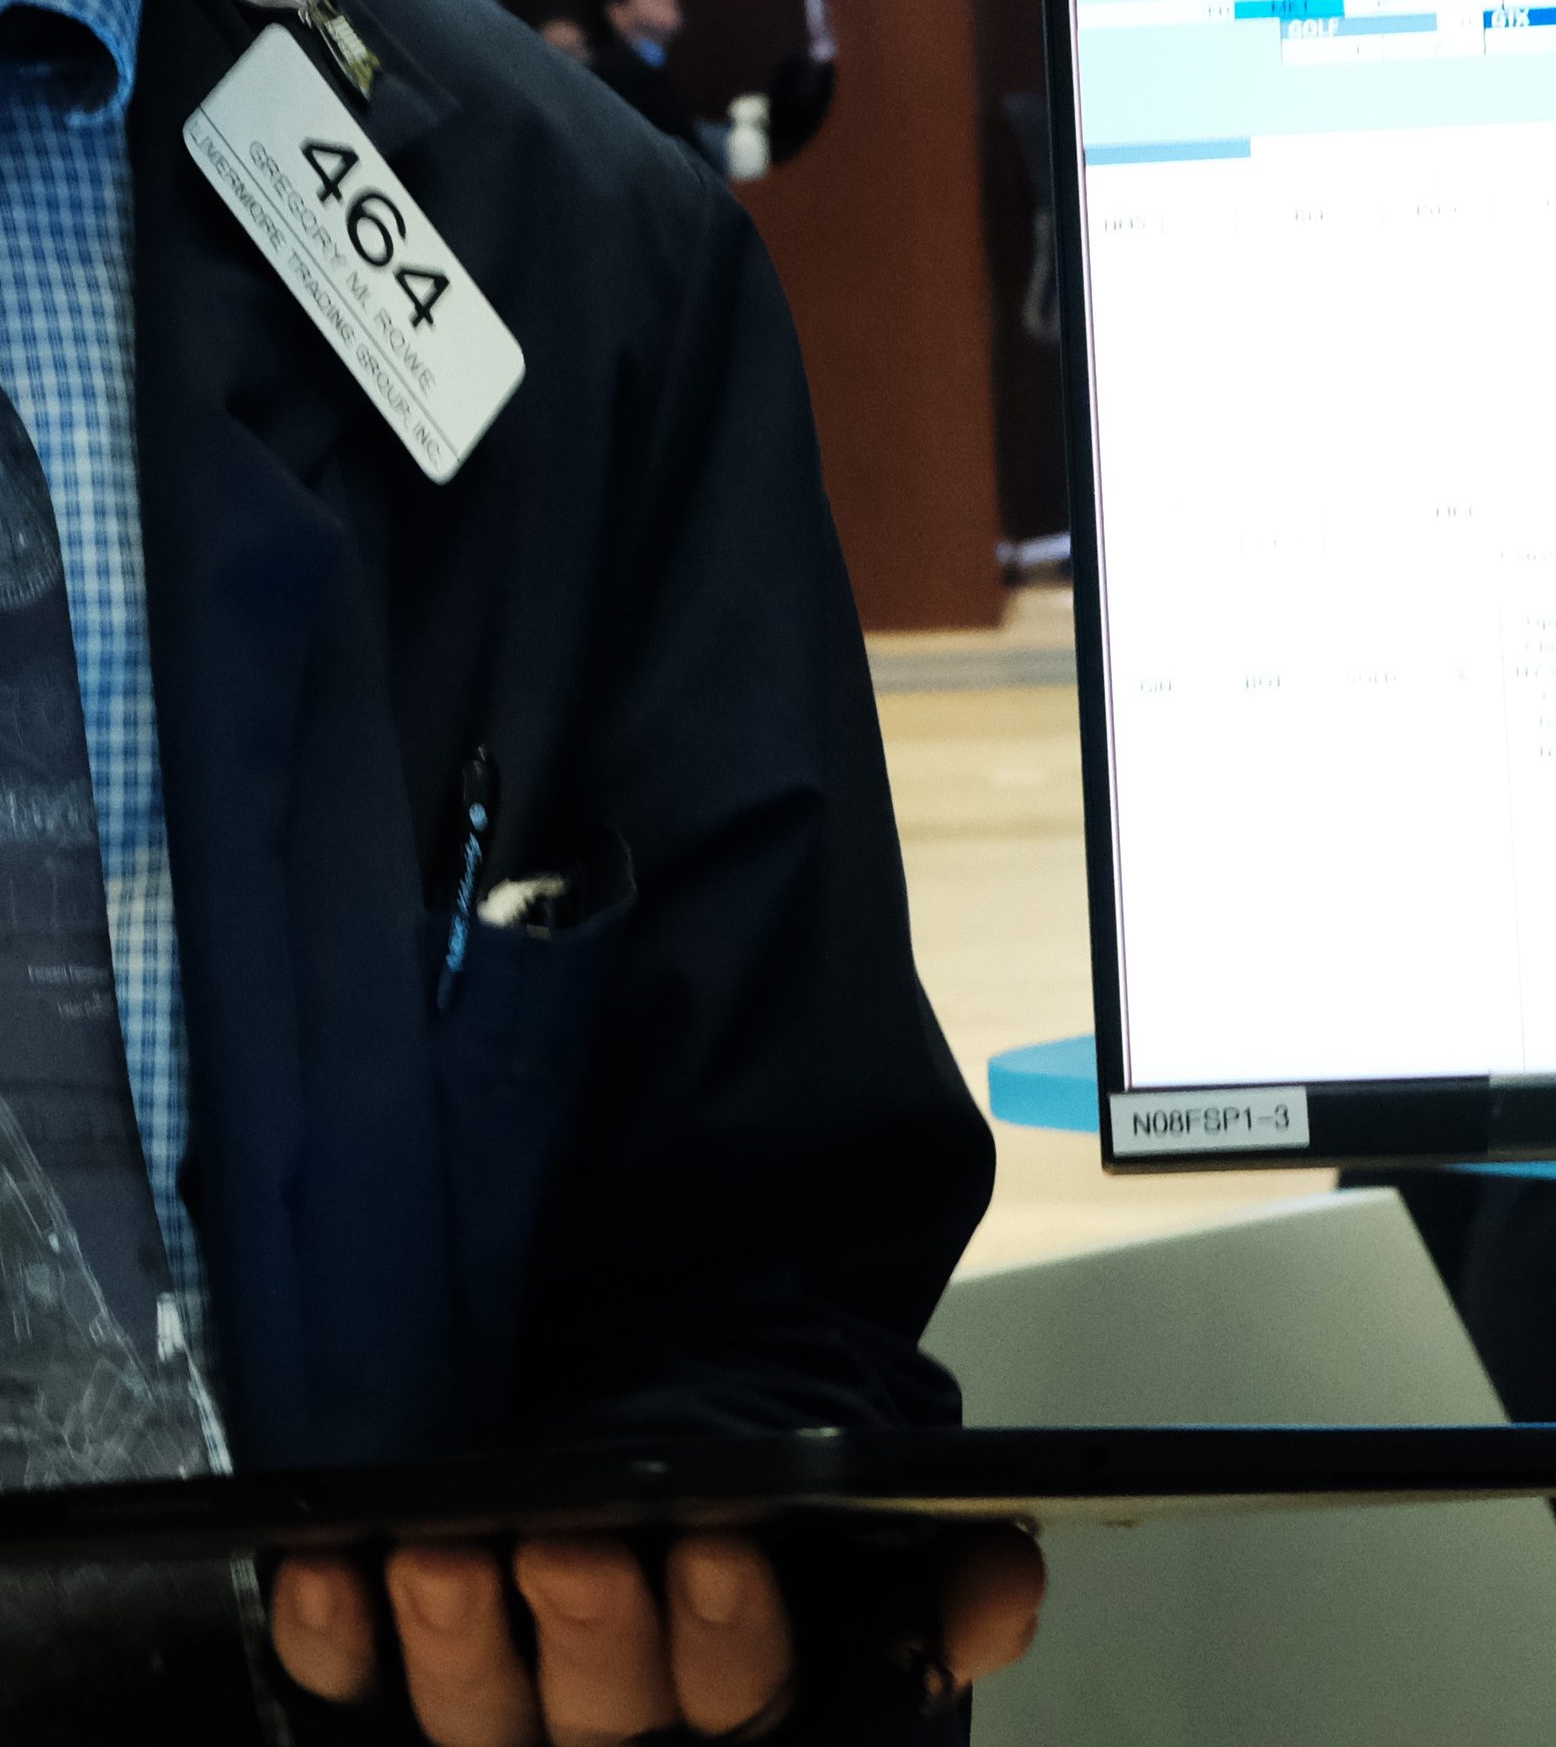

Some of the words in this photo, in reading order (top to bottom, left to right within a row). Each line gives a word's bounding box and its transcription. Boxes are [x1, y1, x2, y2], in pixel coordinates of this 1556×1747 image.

[191, 121, 285, 253] LIVERMORE
[286, 252, 356, 346] TRADING
[248, 141, 347, 276] GREGORY
[373, 302, 438, 395] ROWE
[300, 137, 451, 332] 464
[1133, 1105, 1290, 1139] N08FSP1-3
